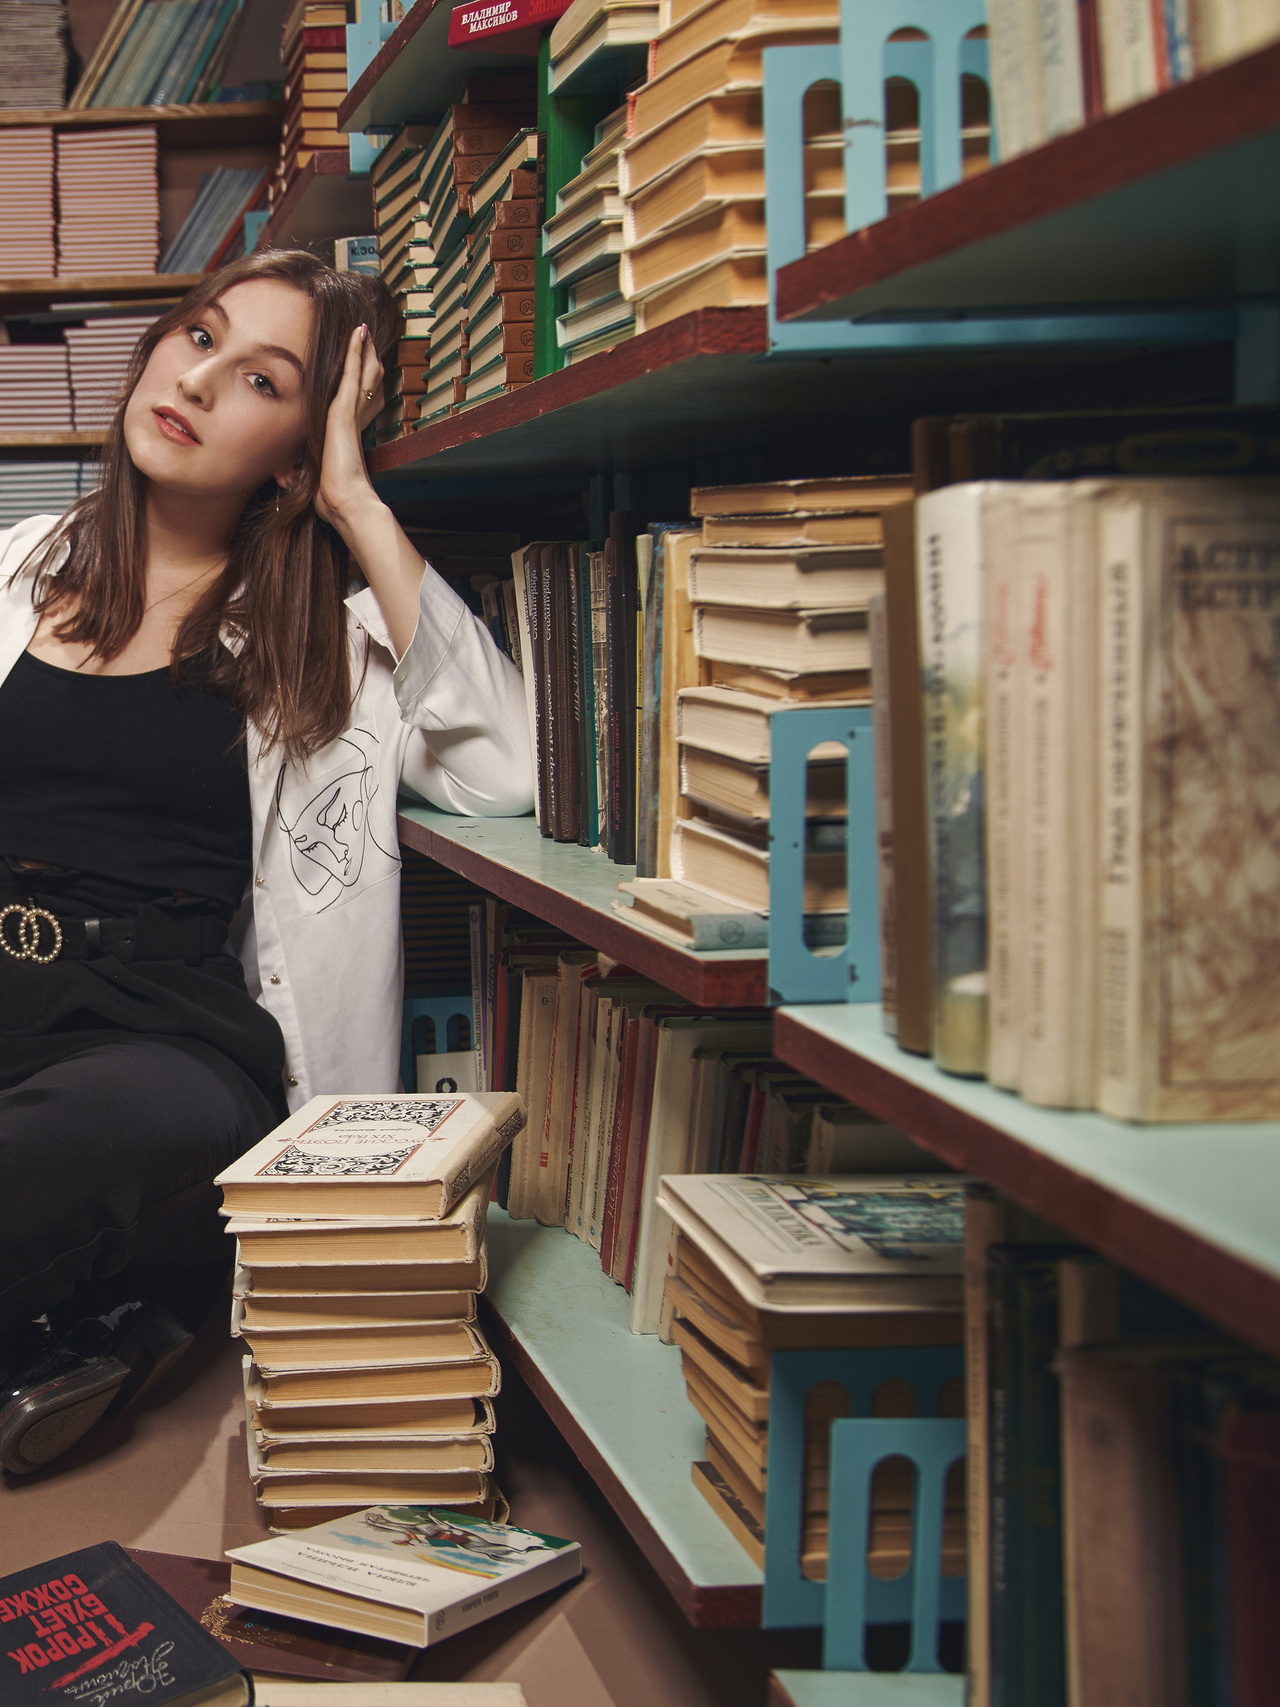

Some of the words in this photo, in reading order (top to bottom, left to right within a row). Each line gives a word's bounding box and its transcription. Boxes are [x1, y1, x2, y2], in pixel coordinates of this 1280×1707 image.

[461, 1, 512, 25] ВЛАДИМИР
[468, 10, 519, 33] МАКСИМОВ
[471, 930, 480, 991] Бонапартом
[473, 1001, 482, 1052] Свидание
[298, 1551, 359, 1572] ИЛЬИНА
[367, 1571, 418, 1587] ЕЛЕНА
[29, 1593, 109, 1638] БУДЕТ
[7, 1613, 136, 1675] ПРОРОК
